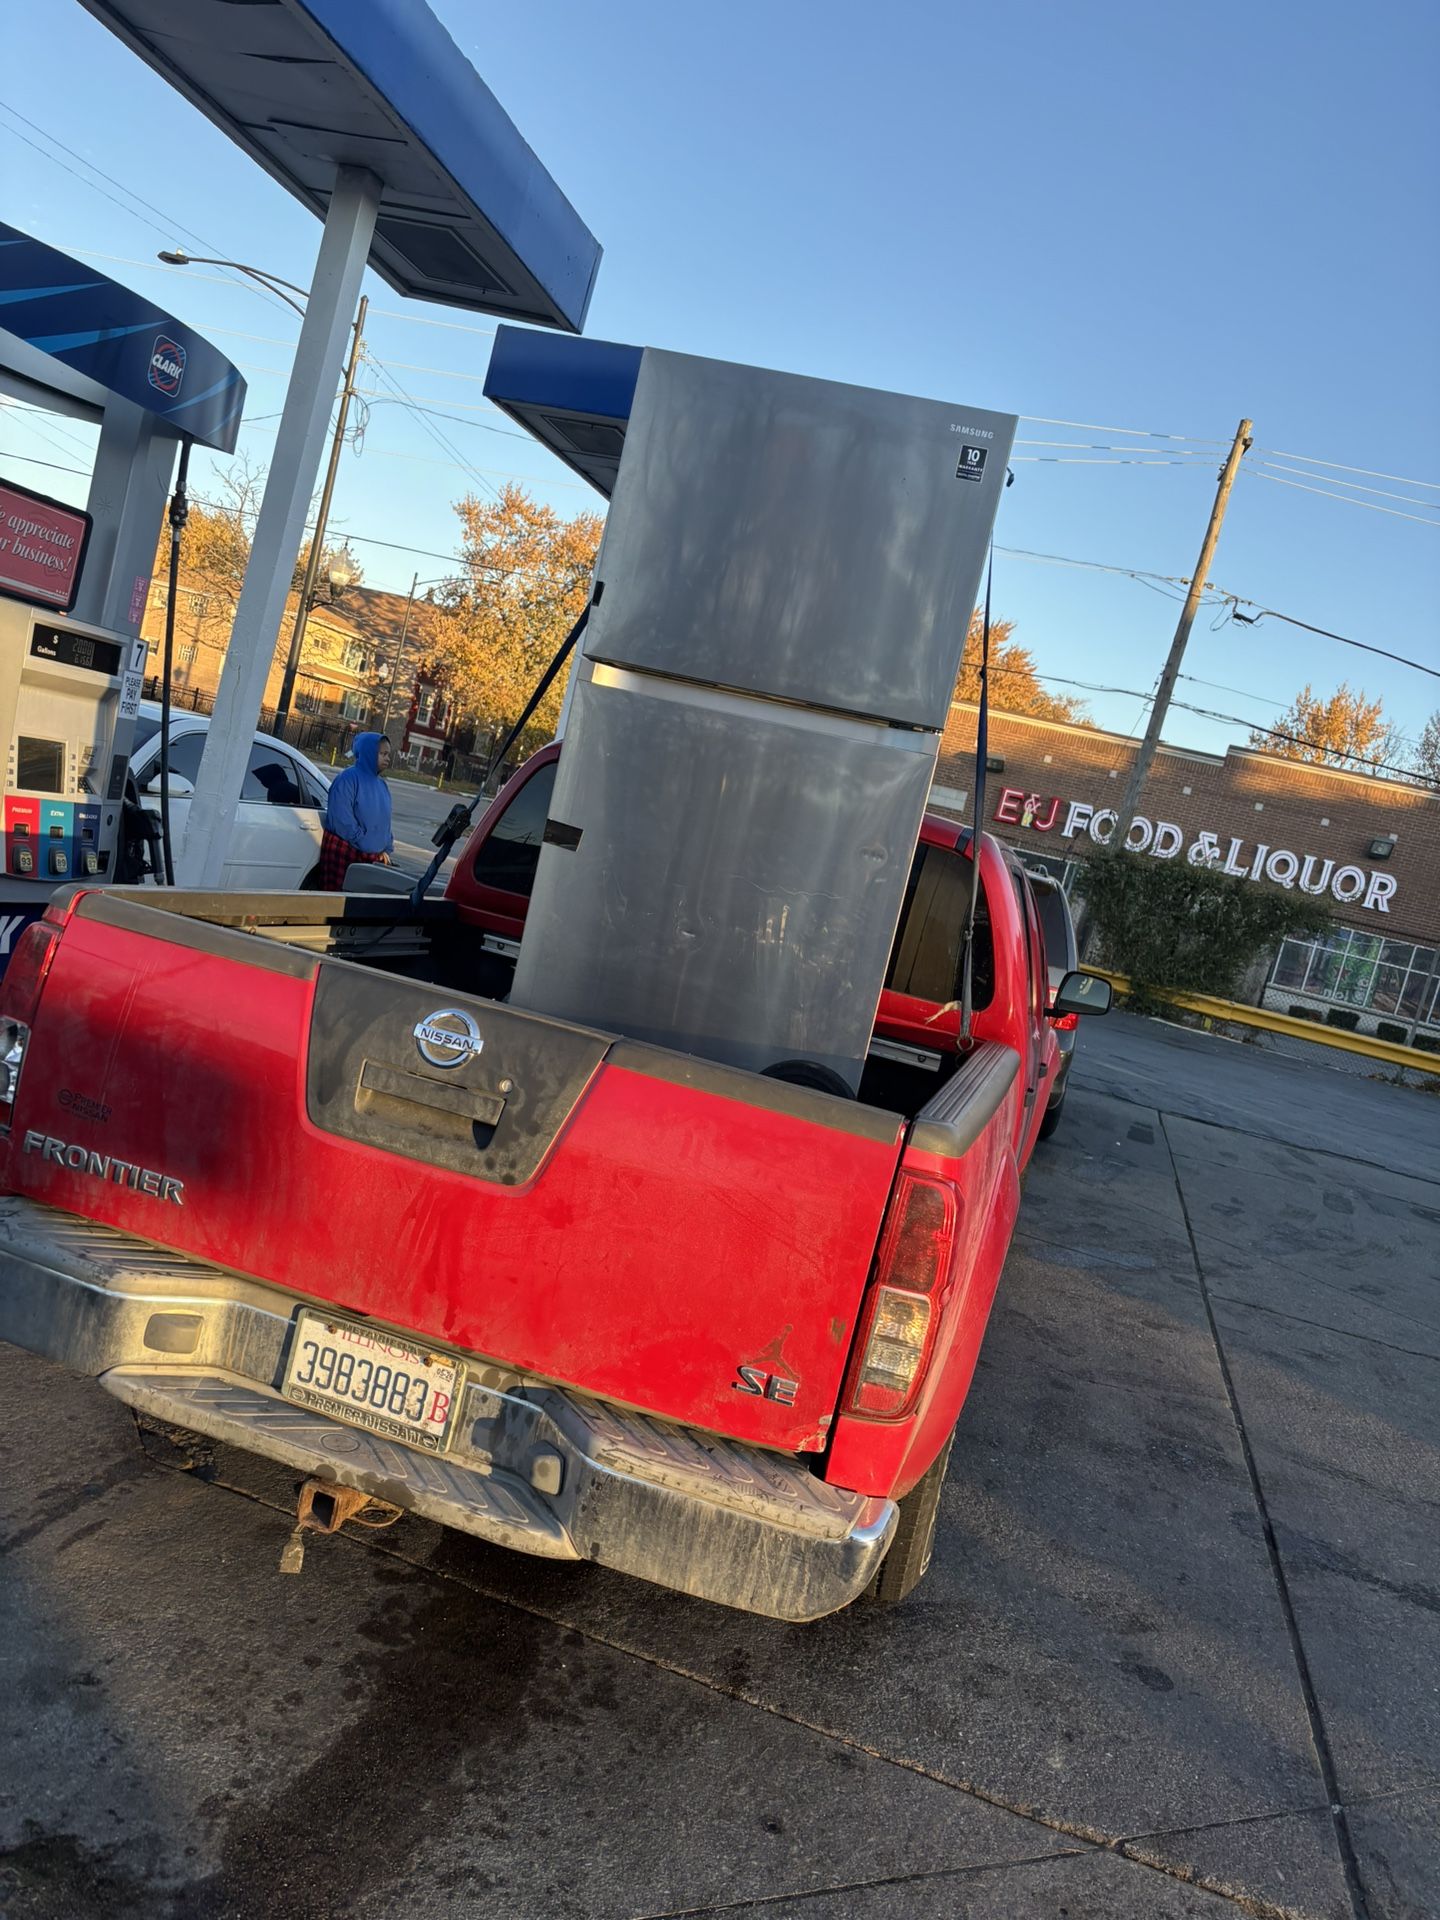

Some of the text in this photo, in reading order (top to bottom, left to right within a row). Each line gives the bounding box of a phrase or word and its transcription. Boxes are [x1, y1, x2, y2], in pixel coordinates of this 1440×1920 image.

[152, 354, 183, 379] CLARK
[950, 423, 994, 439] SAMSUNG
[967, 448, 980, 462] 10
[8, 514, 75, 549] appreciate
[11, 537, 72, 571] business!
[36, 645, 57, 657] Gallons
[136, 643, 145, 668] 7
[125, 676, 142, 688] PLEASE
[126, 688, 138, 700] PAY
[120, 701, 138, 715] FIRST
[21, 857, 32, 866] 93
[1061, 800, 1183, 859] FOOD
[1222, 837, 1398, 914] LIQUOR
[420, 1027, 475, 1050] NISSAN
[22, 1129, 185, 1205] FRONTIER
[341, 1328, 419, 1365] ILLINOIS
[296, 1340, 450, 1424] 3983883 B
[731, 1365, 799, 1408] SE
[305, 1391, 421, 1446] PREMIER NISSAN
